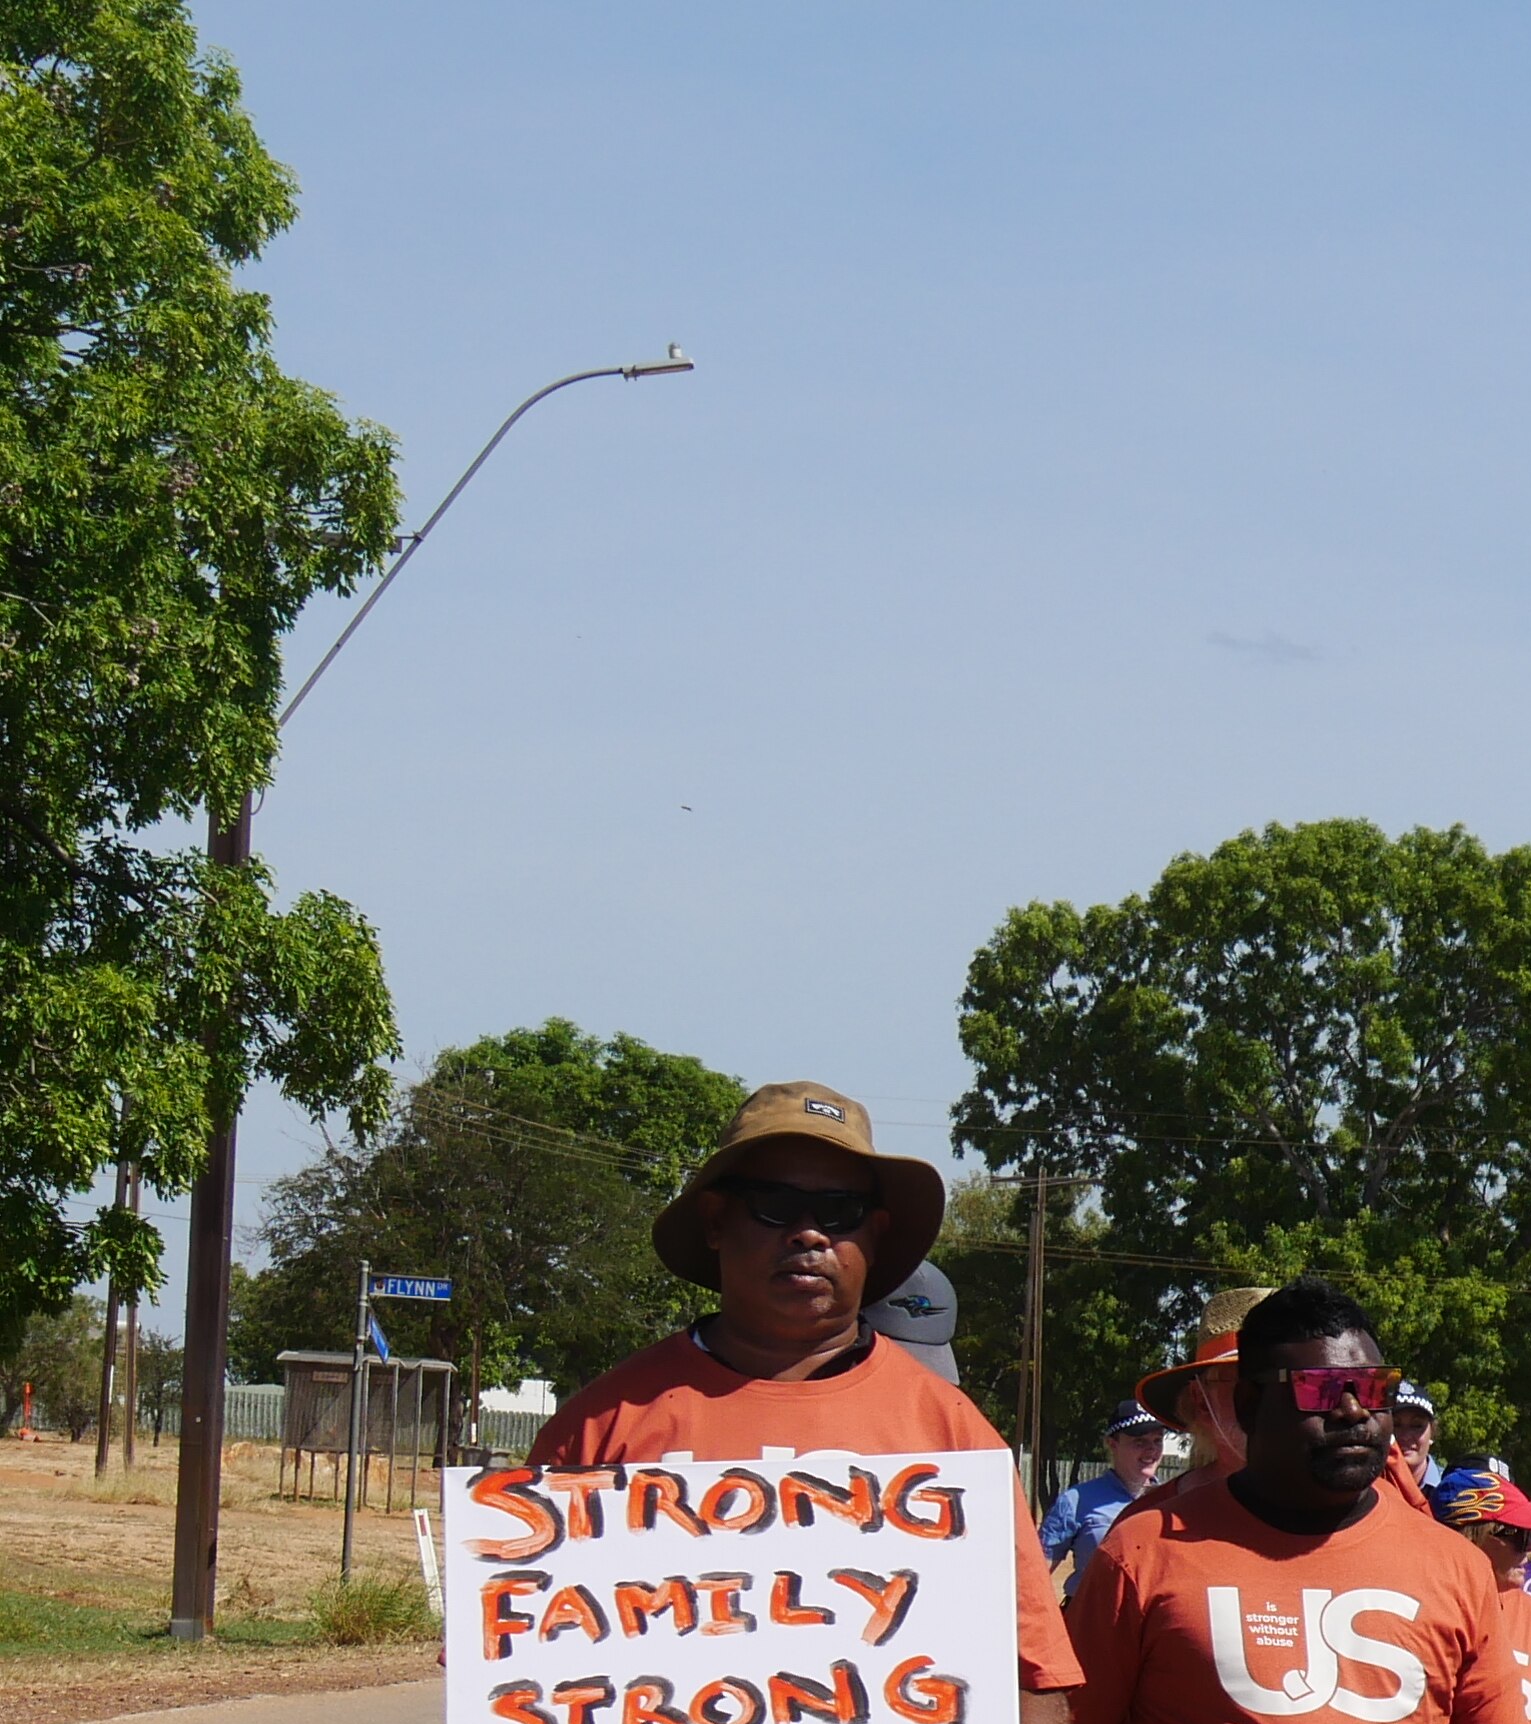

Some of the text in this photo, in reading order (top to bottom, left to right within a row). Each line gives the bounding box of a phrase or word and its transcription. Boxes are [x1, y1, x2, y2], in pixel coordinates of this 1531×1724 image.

[387, 1278, 436, 1297] FLYNN
[461, 1463, 967, 1564] STRONG
[481, 1568, 918, 1661] FAMILY
[1266, 1601, 1277, 1612] is
[1246, 1613, 1299, 1627] stronger
[1249, 1624, 1298, 1637] without
[1256, 1636, 1294, 1647] abuse
[1207, 1586, 1427, 1723] US
